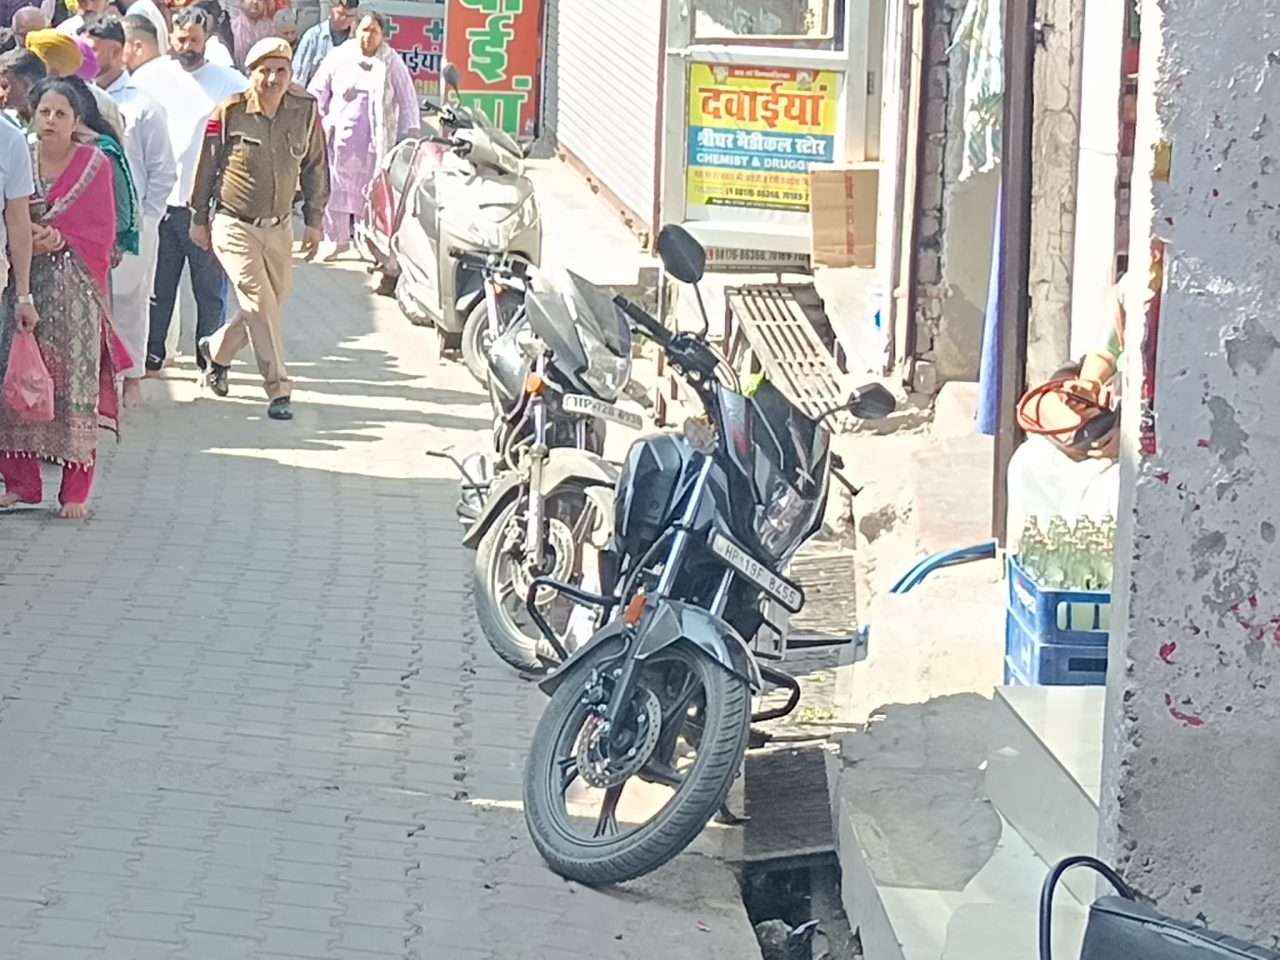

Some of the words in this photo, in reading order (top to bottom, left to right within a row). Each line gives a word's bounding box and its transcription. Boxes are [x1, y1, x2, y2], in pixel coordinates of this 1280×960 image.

[699, 83, 827, 128] दवाईयां
[696, 153, 750, 167] CHEMIST
[795, 135, 827, 155] स्टोर
[724, 544, 740, 561] HP
[768, 577, 798, 605] 8455
